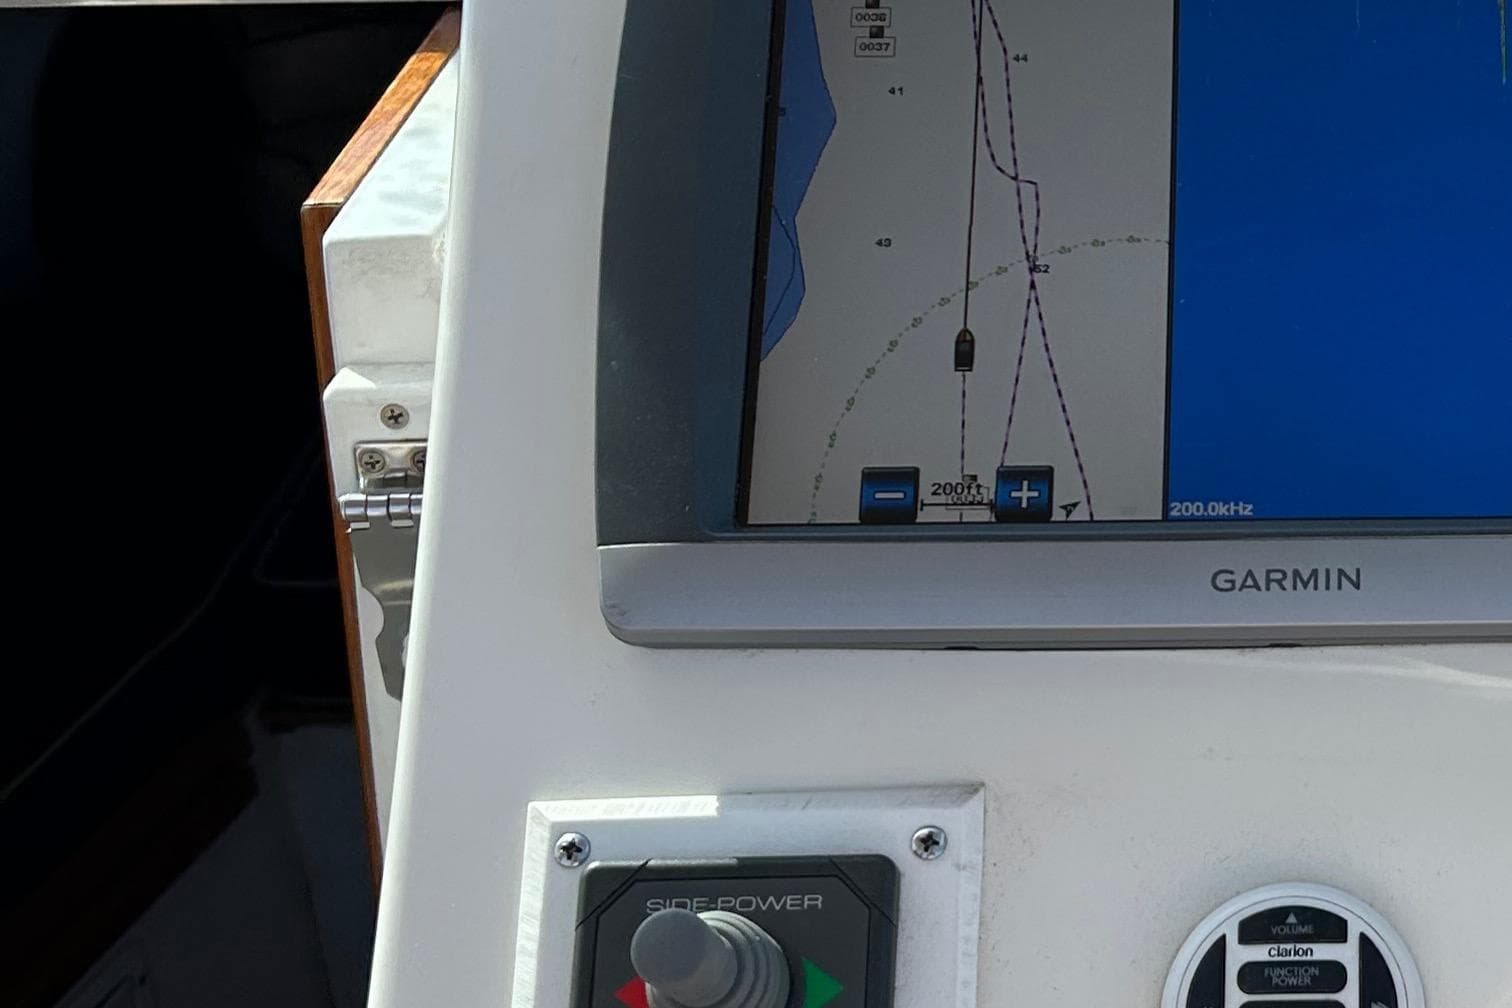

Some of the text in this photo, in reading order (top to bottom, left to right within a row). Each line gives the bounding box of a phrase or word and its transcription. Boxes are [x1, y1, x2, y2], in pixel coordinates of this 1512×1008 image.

[858, 41, 890, 52] 0037
[930, 481, 985, 496] 200ft
[1170, 501, 1254, 516] 200.0kHz
[1210, 567, 1361, 592] GARMIN
[645, 894, 824, 915] SIDE-POWER
[1271, 925, 1315, 935] VOLUME
[1263, 966, 1320, 978] FUNCTION
[1271, 976, 1312, 987] POWER
